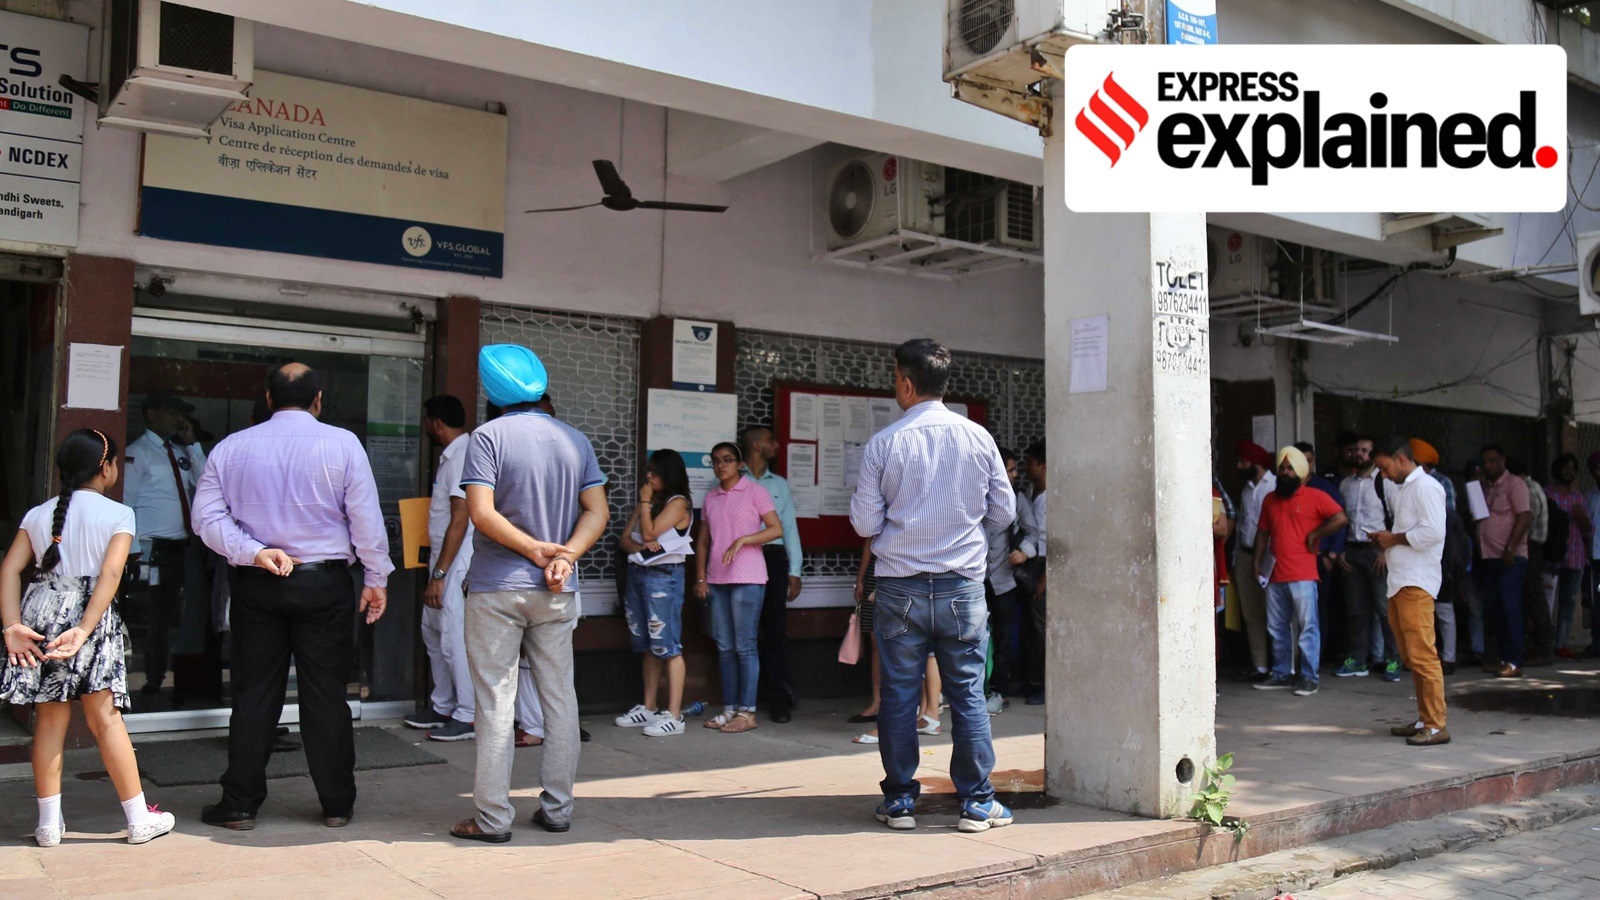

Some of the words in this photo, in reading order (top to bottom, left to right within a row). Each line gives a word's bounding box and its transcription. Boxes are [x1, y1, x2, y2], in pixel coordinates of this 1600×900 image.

[0, 77, 73, 104] Solution
[13, 101, 26, 110] Do
[29, 103, 69, 117] Different
[228, 97, 327, 127] ANADA
[220, 116, 245, 130] Visa
[247, 121, 316, 142] Application
[318, 132, 356, 148] Centre
[9, 146, 69, 169] NCDEX
[218, 135, 260, 151] Centre
[262, 141, 276, 154] de
[279, 144, 333, 163] réception
[336, 153, 354, 166] des
[356, 156, 412, 174] demandes
[414, 165, 427, 177] de
[428, 168, 449, 180] visa
[23, 193, 64, 209] Sweets,
[884, 182, 897, 196] LG
[1229, 253, 1242, 264] LG
[1157, 290, 1207, 316] 9876234411
